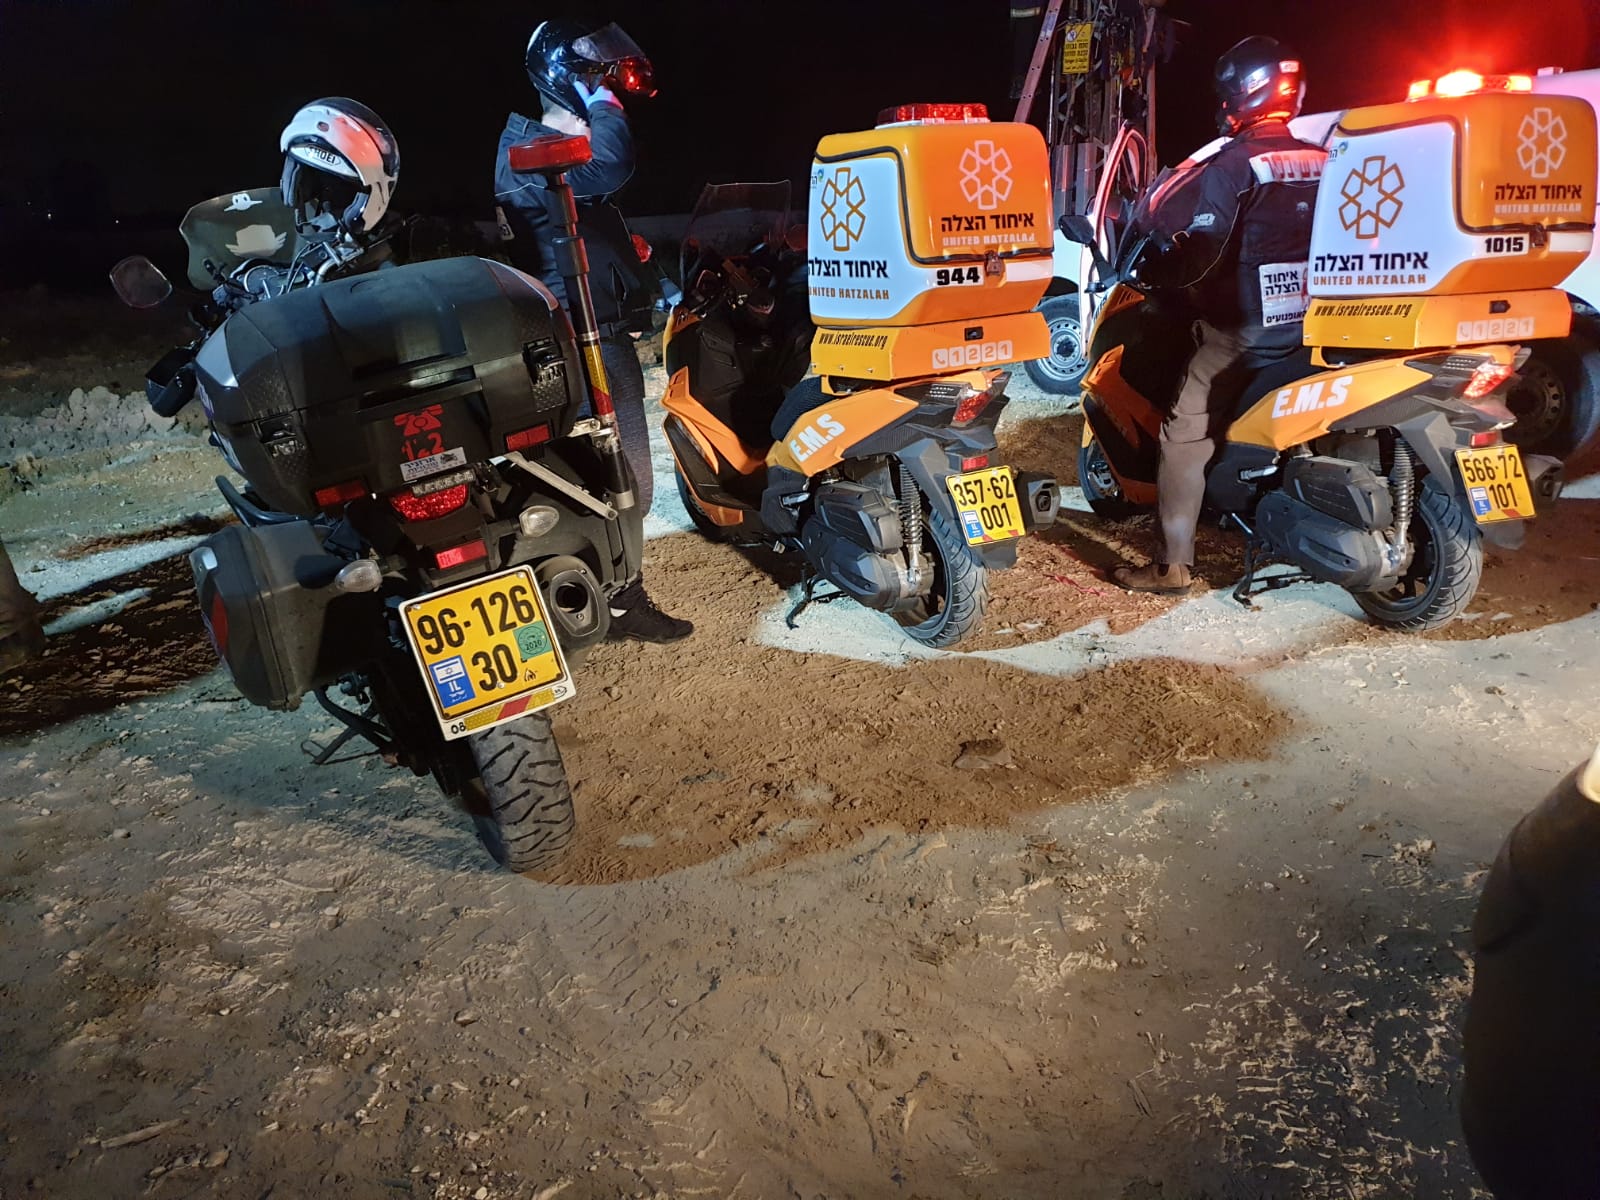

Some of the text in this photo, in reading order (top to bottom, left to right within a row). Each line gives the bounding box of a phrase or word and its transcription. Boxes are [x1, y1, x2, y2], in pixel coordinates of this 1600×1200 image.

[1495, 183, 1582, 200] איחוד הצלה
[941, 213, 1034, 232] איחוד הצלה
[943, 236, 980, 246] UNITED
[1485, 237, 1523, 253] 1015
[808, 257, 889, 278] איחוד הצלה
[1315, 252, 1429, 272] איחוד הצלה
[937, 267, 980, 286] 944
[1264, 271, 1298, 283] איחוד
[1314, 274, 1426, 285] UNITED HATZALAH
[839, 288, 889, 299] HATZALAH
[1265, 282, 1300, 295] הצלה
[1314, 303, 1412, 318] www.israelrescue.org
[1475, 319, 1532, 338] 1221
[819, 332, 888, 350] www.israelrescue.org
[951, 342, 1010, 364] 1221
[1272, 375, 1353, 418] E.M.S
[790, 414, 846, 462] E.M.S
[1489, 483, 1518, 508] 101
[980, 503, 1012, 530] 001
[471, 644, 518, 691] 30
[448, 681, 459, 692] IL
[451, 722, 466, 734] 08
